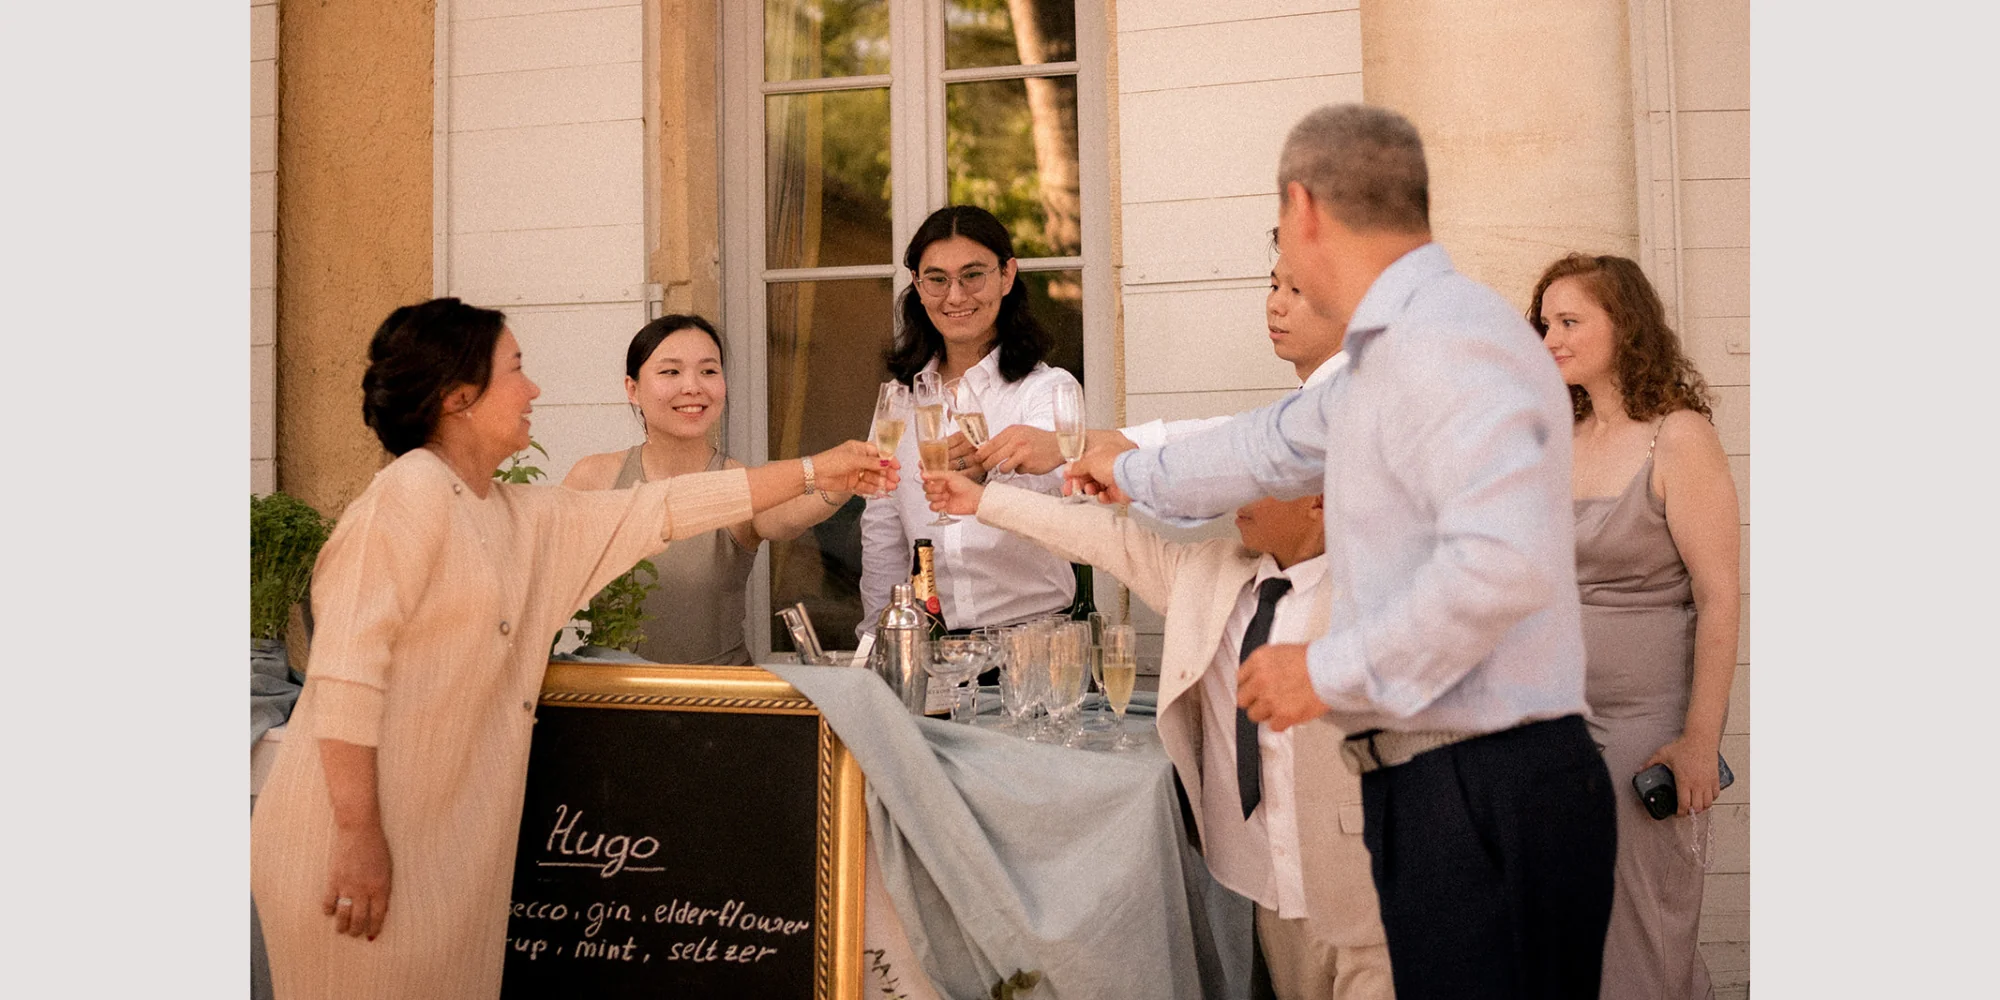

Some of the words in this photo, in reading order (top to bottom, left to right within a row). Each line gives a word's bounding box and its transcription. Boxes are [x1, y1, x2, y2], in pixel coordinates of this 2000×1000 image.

[546, 804, 660, 878] Hugo
[654, 898, 810, 935] elderflower
[667, 936, 778, 963] seltzer
